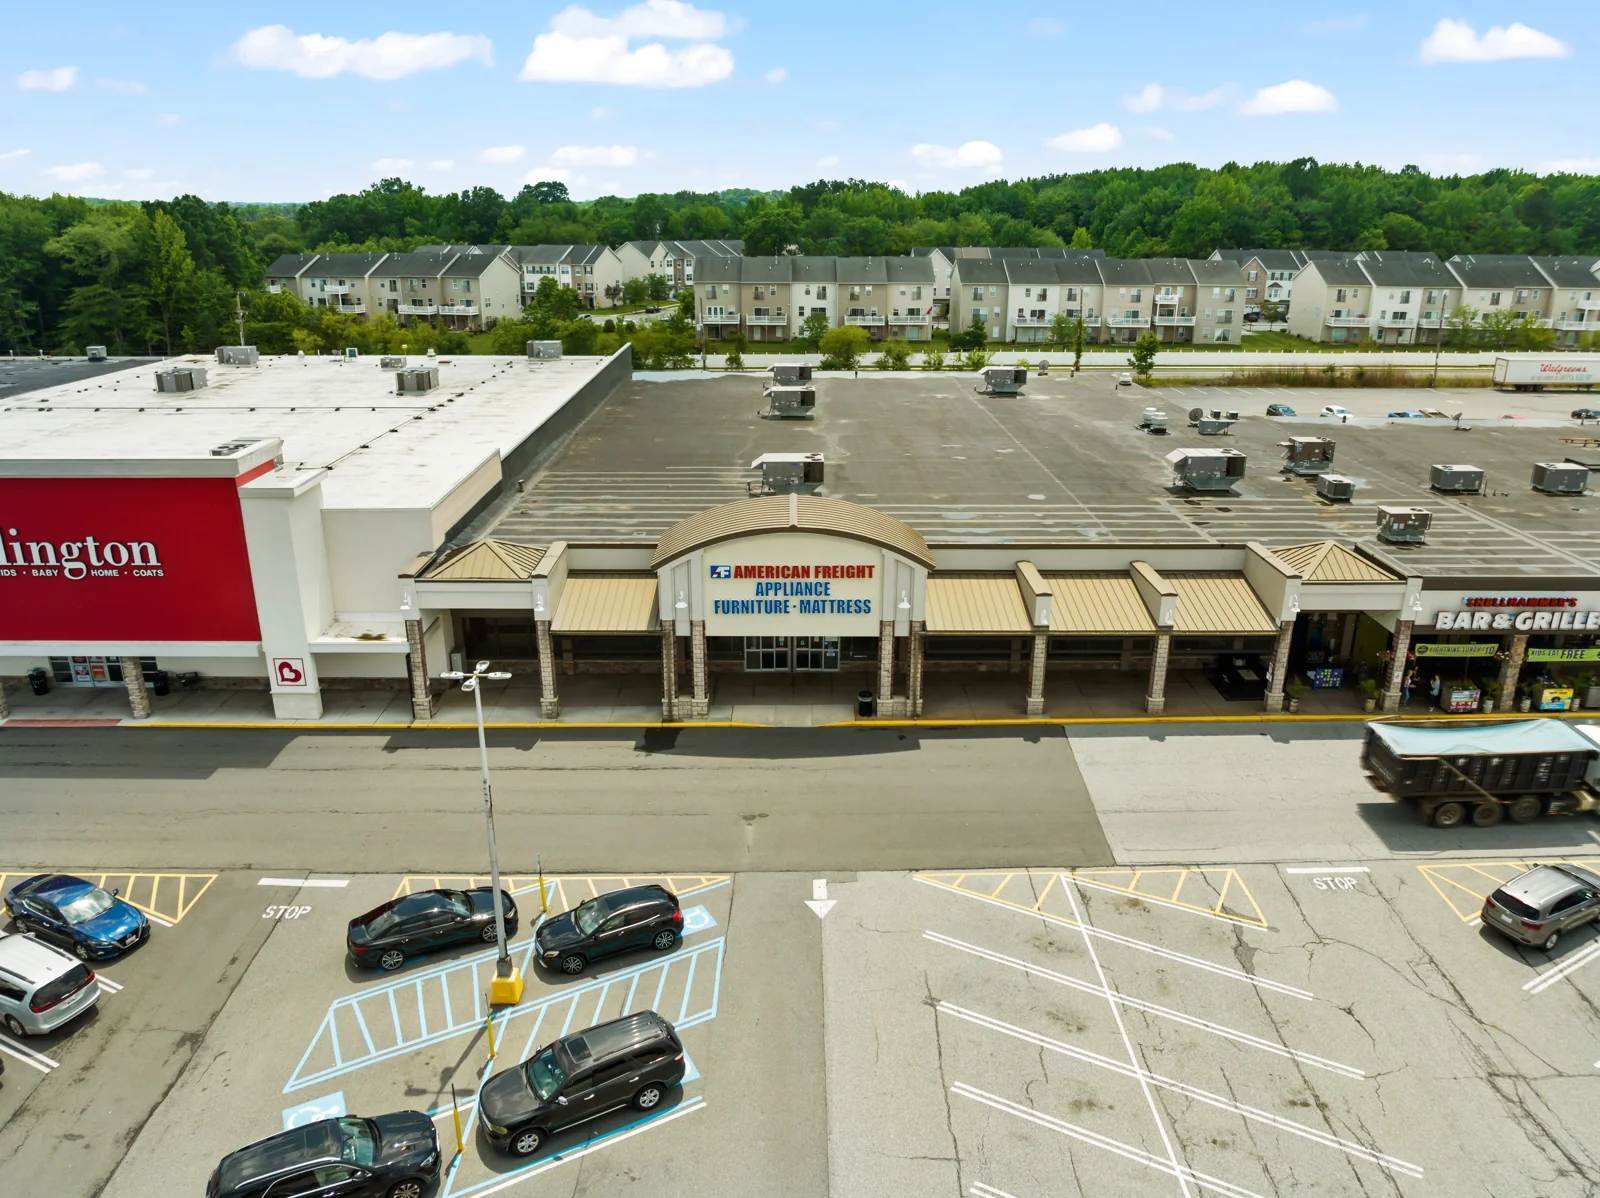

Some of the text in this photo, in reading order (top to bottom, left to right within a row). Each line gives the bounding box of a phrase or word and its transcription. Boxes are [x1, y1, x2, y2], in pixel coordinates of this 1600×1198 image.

[1540, 364, 1588, 375] Walgreens
[0, 569, 164, 577] IDS BABY HOME COATS
[733, 565, 811, 579] AMERICAN
[814, 564, 876, 579] FREIGHT
[755, 581, 831, 597] APPLIANCE
[714, 598, 872, 615] FURNITURE MATTRESS
[1435, 610, 1600, 631] BAR & GRILLE
[1560, 649, 1585, 660] FREE
[1313, 877, 1358, 890] STOP
[262, 905, 312, 919] STOP
